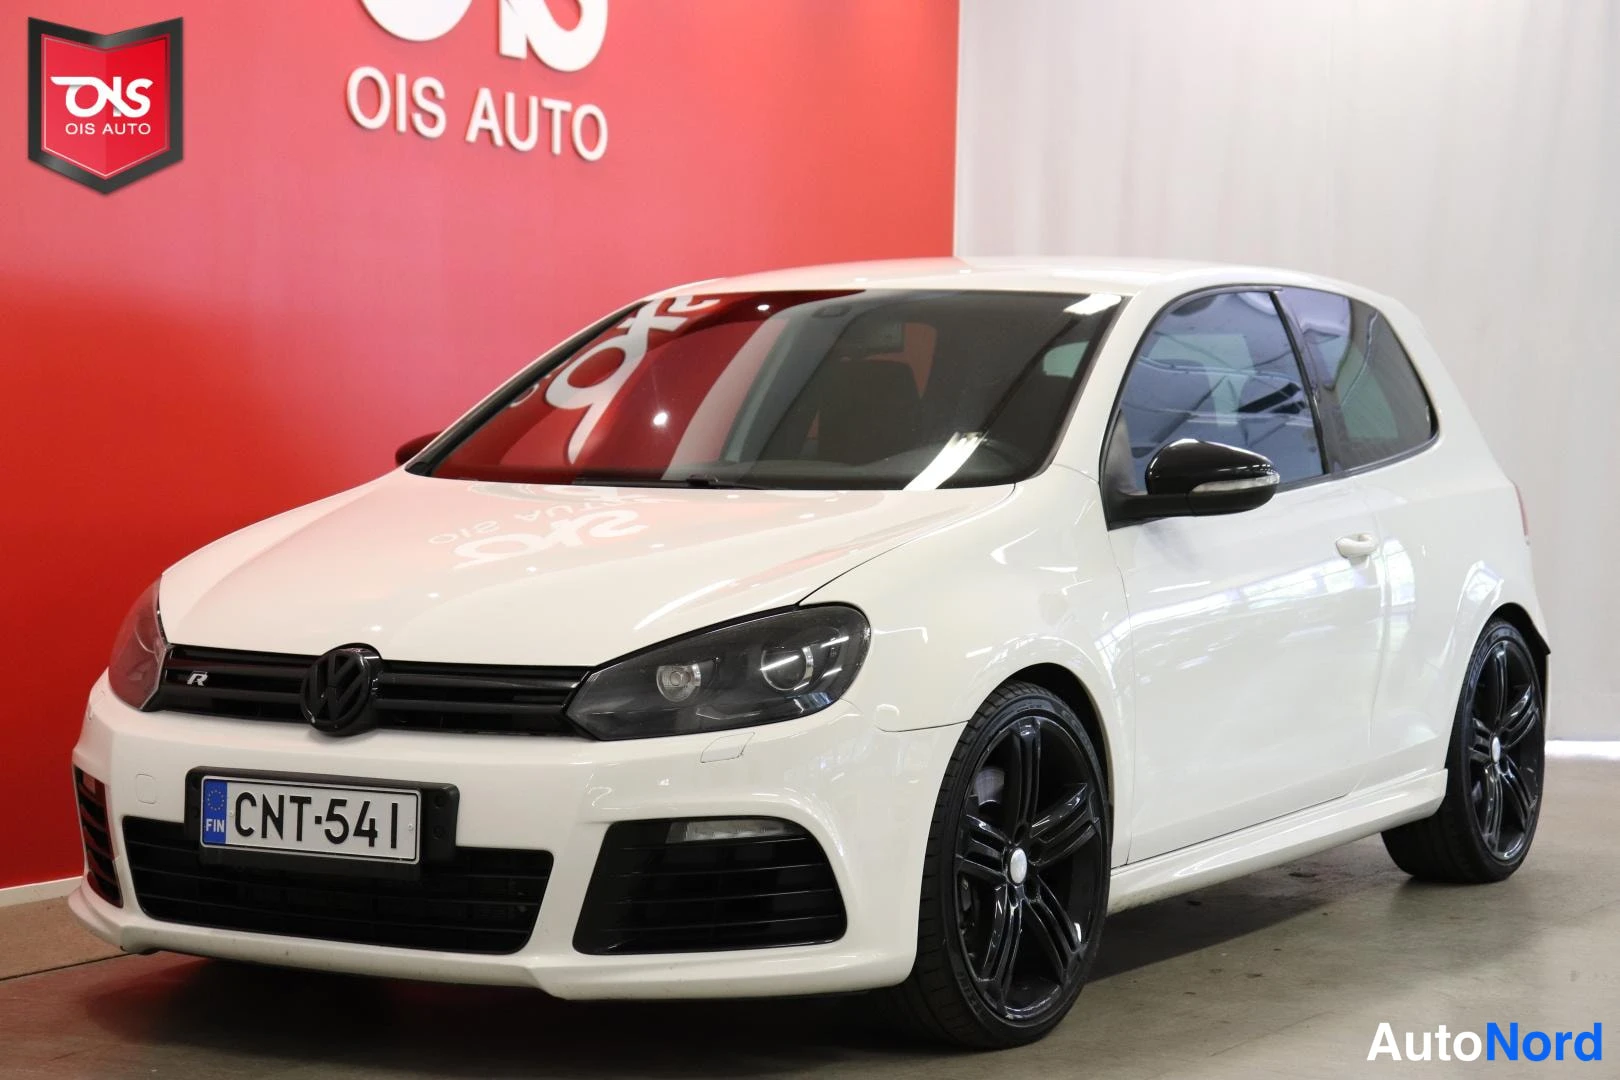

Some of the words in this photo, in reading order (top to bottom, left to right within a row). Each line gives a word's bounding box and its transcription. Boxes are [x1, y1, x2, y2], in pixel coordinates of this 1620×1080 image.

[346, 66, 447, 138] OIS
[465, 87, 608, 161] AUTO
[186, 671, 209, 687] R
[205, 818, 225, 834] FIN
[234, 791, 399, 850] CNT-541
